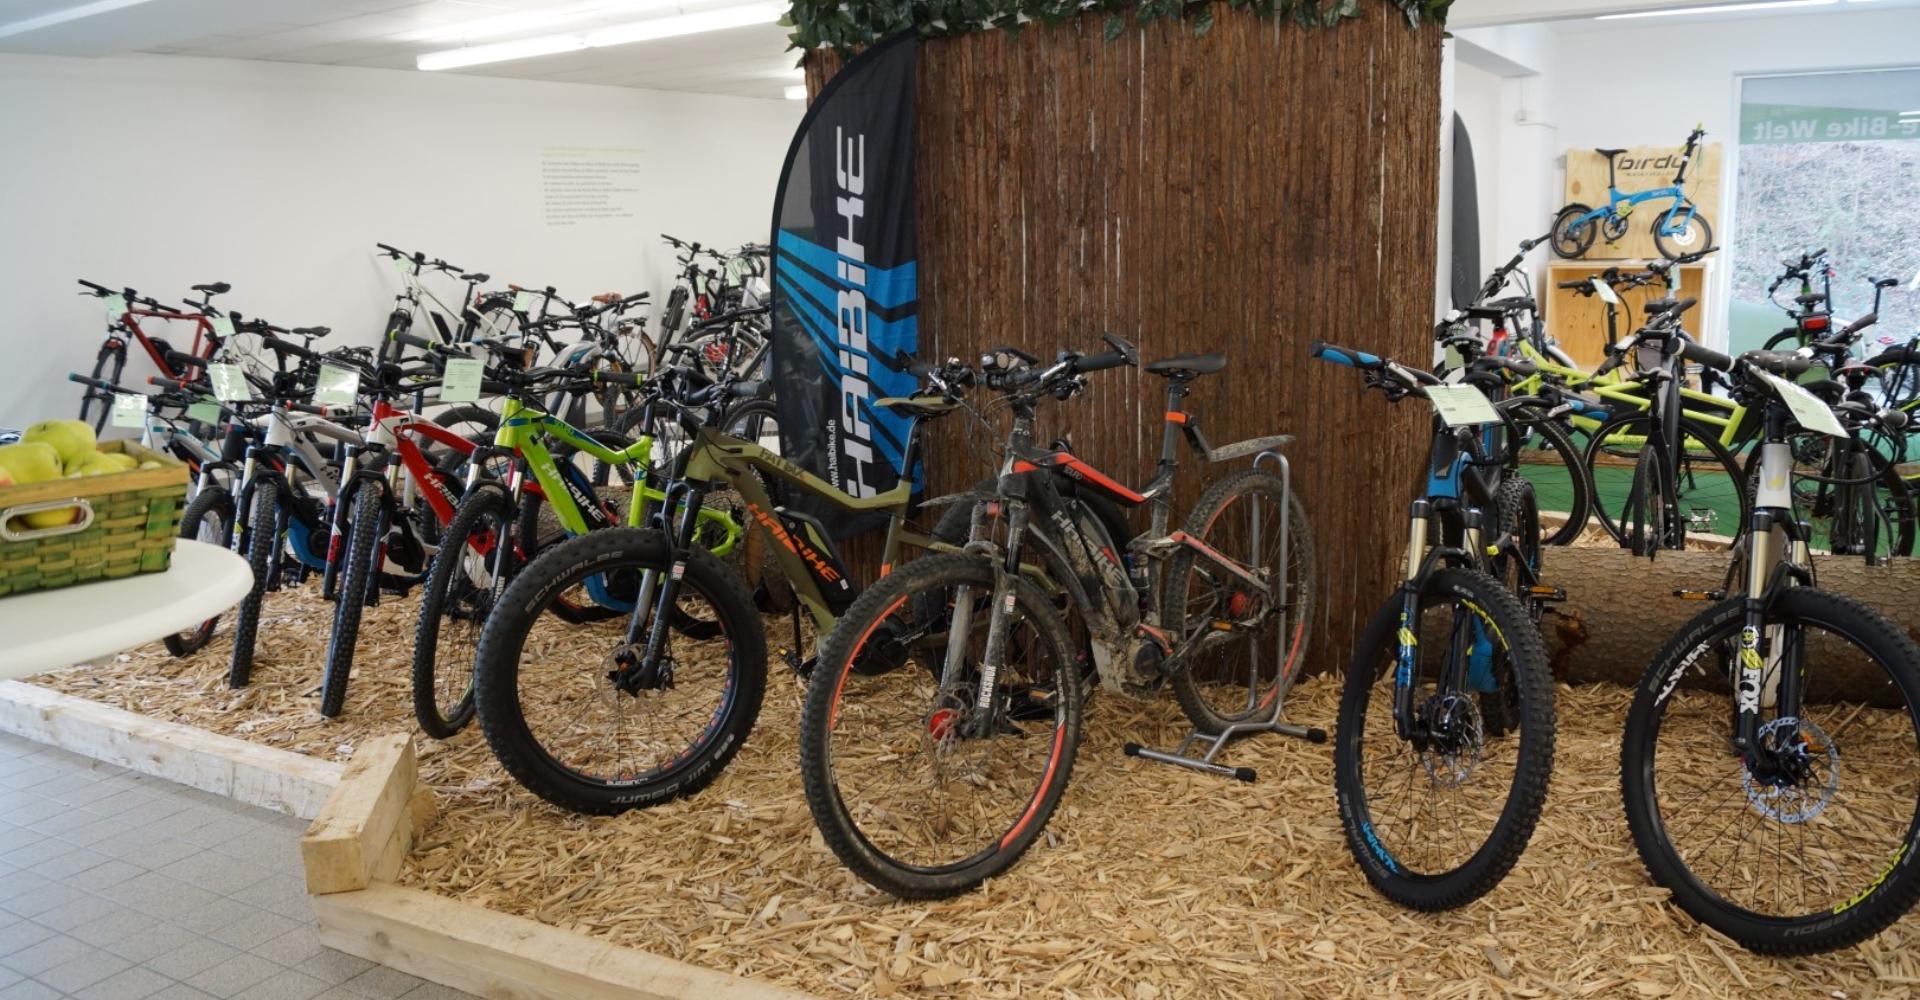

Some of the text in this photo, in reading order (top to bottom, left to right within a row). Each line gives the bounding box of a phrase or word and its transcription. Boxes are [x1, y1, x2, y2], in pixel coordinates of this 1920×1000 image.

[836, 125, 877, 499] HAIBIKE
[825, 418, 841, 492] ww.haibike.de
[525, 550, 623, 613] SCHWALBE
[1649, 606, 1740, 693] SCHWALBE
[978, 665, 997, 709] ROCKSHOX
[1739, 667, 1762, 715] FOX
[610, 760, 712, 805] JUMBO JIM
